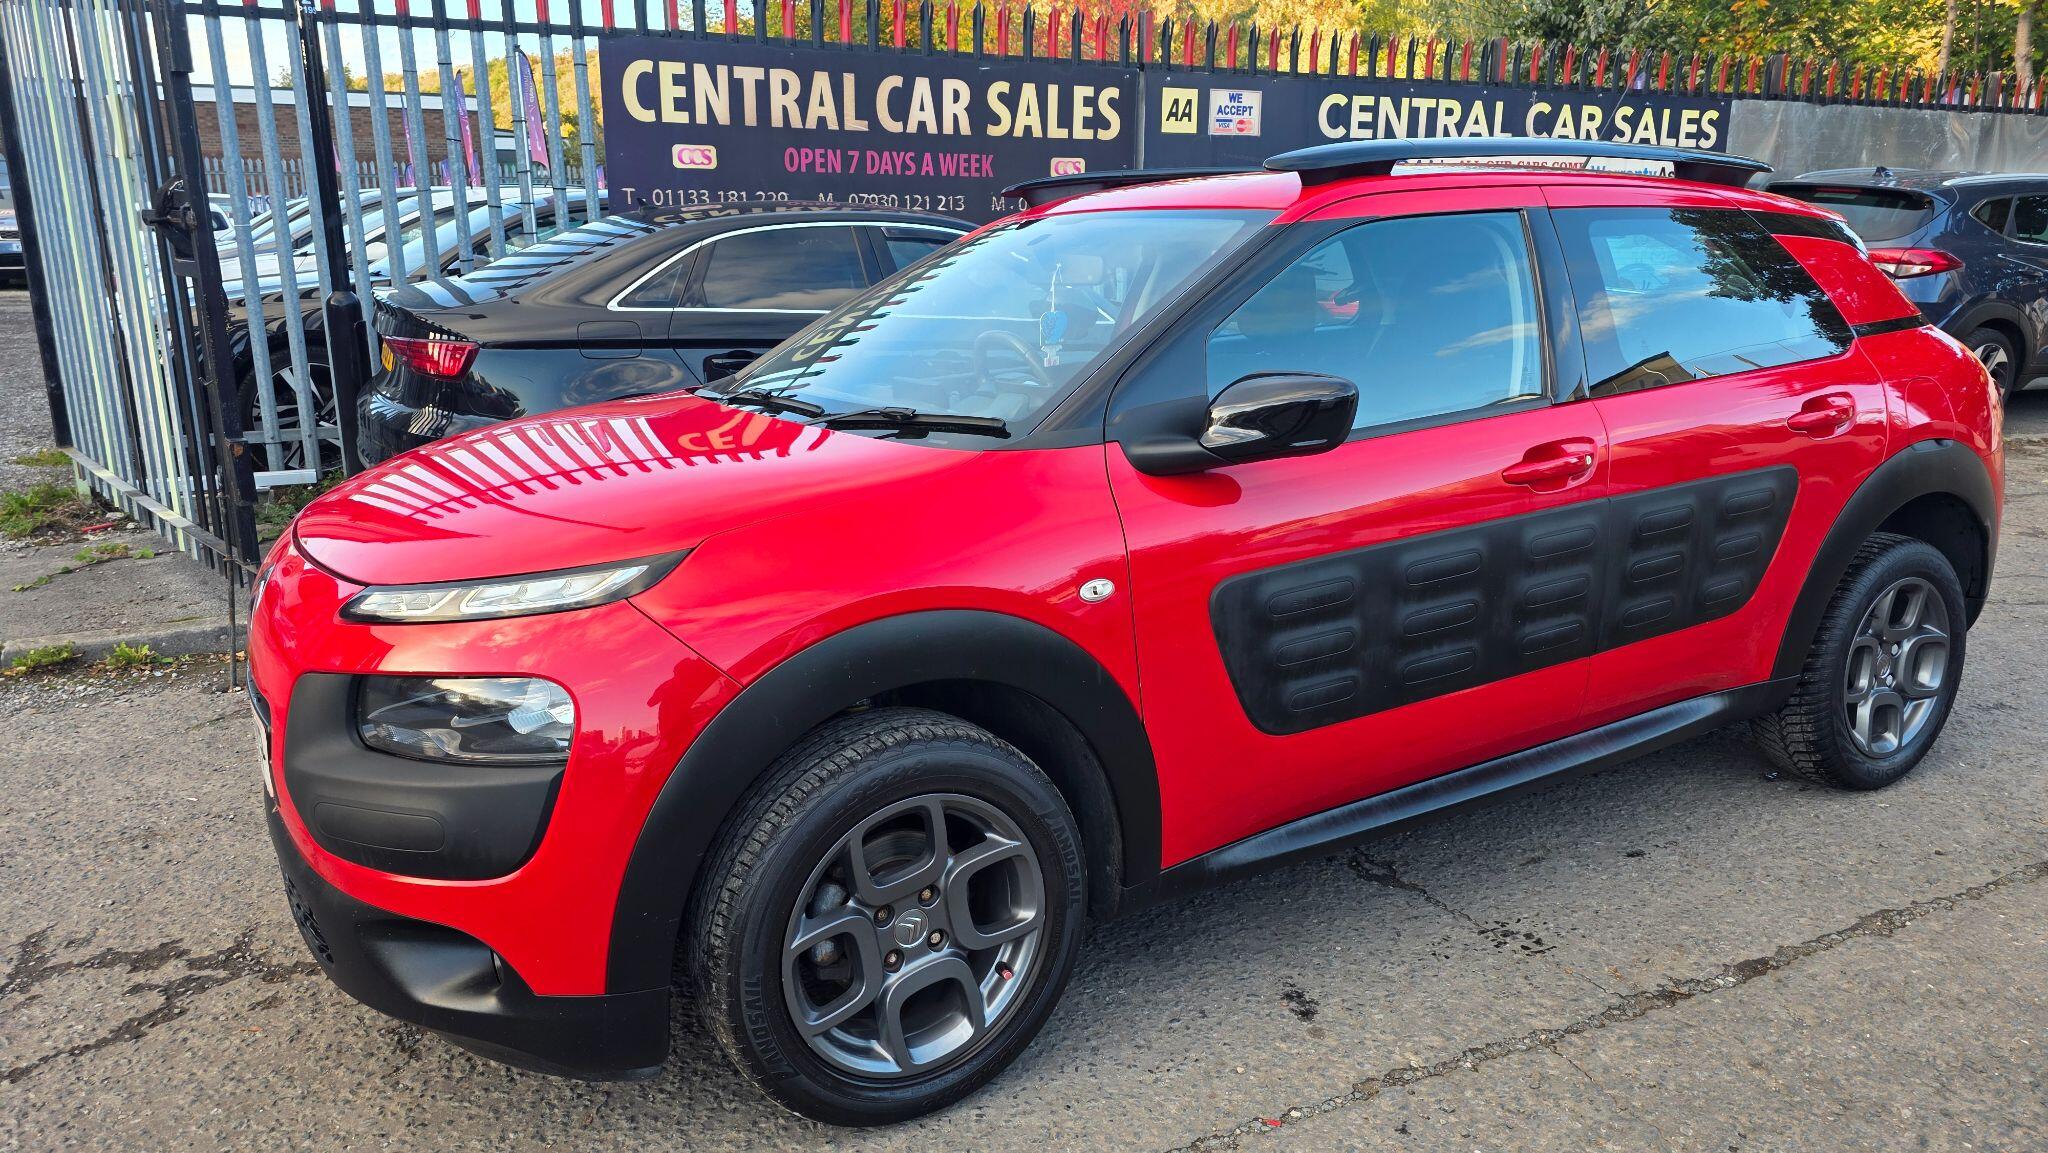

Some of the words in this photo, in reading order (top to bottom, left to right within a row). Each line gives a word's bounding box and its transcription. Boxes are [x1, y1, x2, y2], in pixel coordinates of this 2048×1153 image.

[622, 59, 869, 132] CENTRAL
[875, 75, 972, 136] CAR
[986, 80, 1121, 141] SALES
[1166, 97, 1193, 122] AA
[1216, 104, 1254, 117] ACCEPT
[1228, 92, 1243, 104] WE
[1318, 93, 1513, 140] CENTRAL
[1525, 102, 1603, 141] CAR
[1611, 105, 1720, 149] SALES
[784, 147, 842, 174] OPEN
[847, 150, 860, 174] 7
[866, 150, 915, 176] DAYS
[921, 152, 935, 177] A
[938, 152, 995, 178] WEEK
[652, 188, 710, 206] 01133
[904, 194, 930, 210] 121
[937, 195, 966, 211] 213
